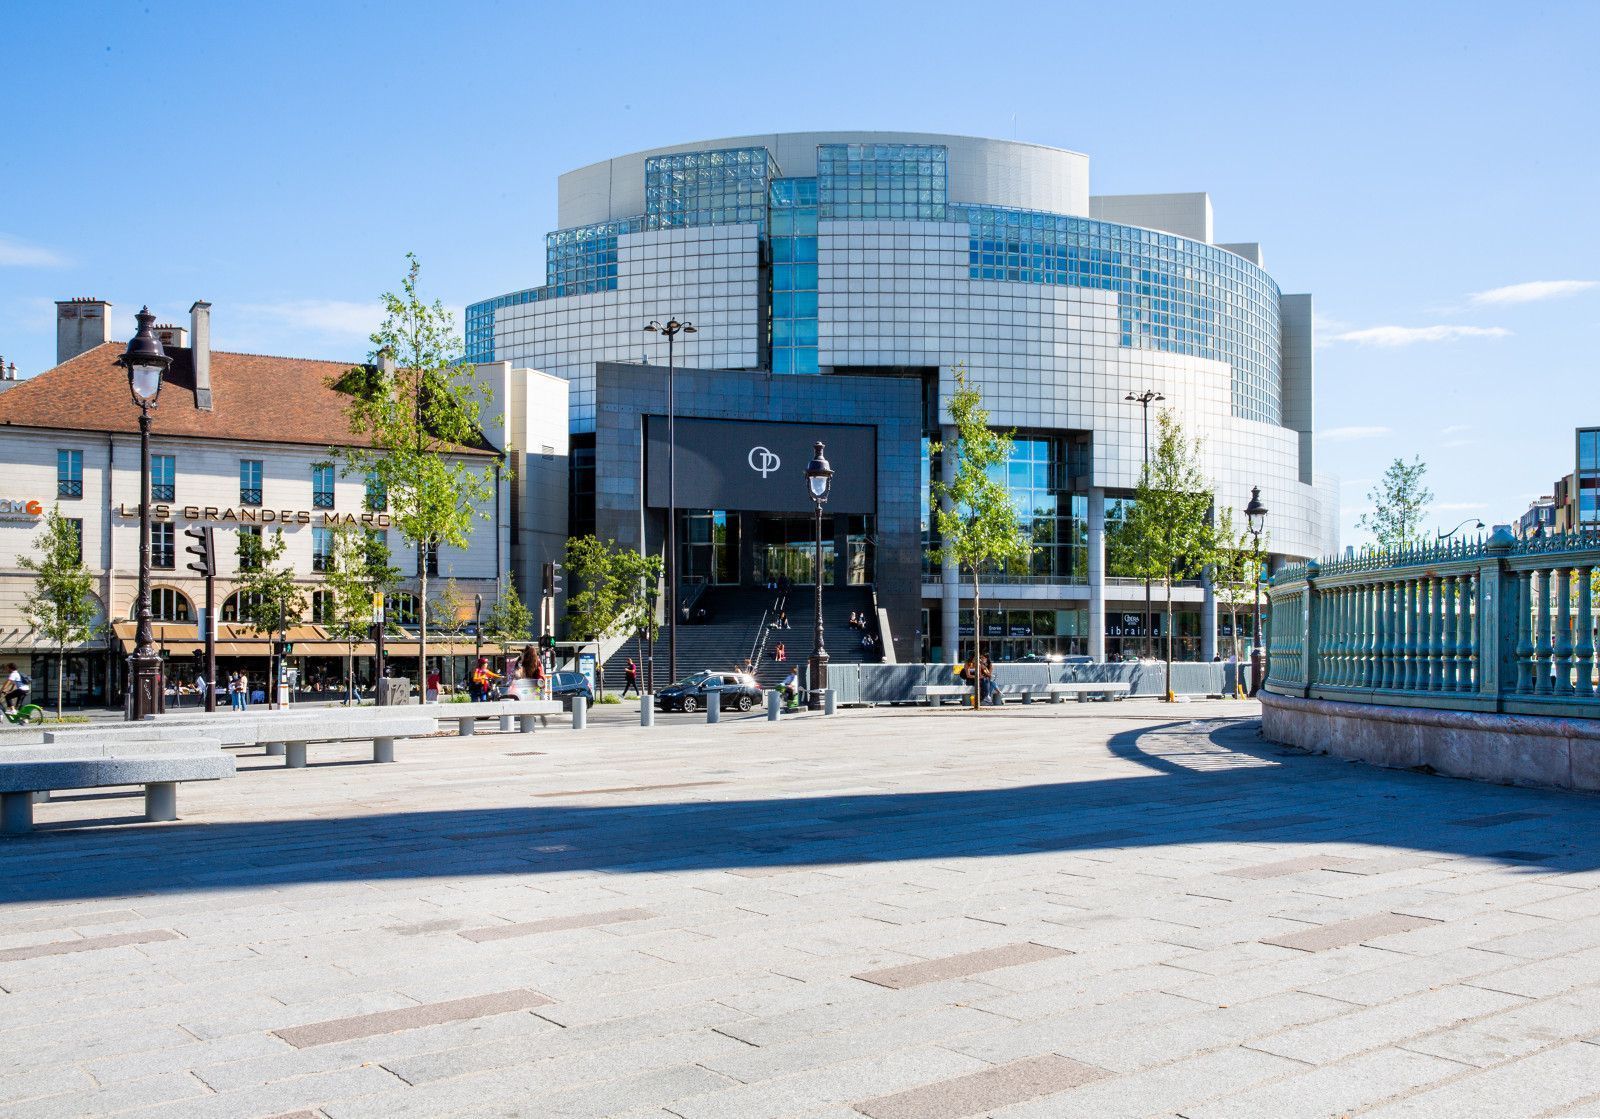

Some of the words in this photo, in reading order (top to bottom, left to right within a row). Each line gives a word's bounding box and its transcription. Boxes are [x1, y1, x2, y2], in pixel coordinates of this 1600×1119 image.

[0, 499, 42, 515] CMG
[121, 503, 170, 519] LS
[184, 506, 310, 524] GRANDES
